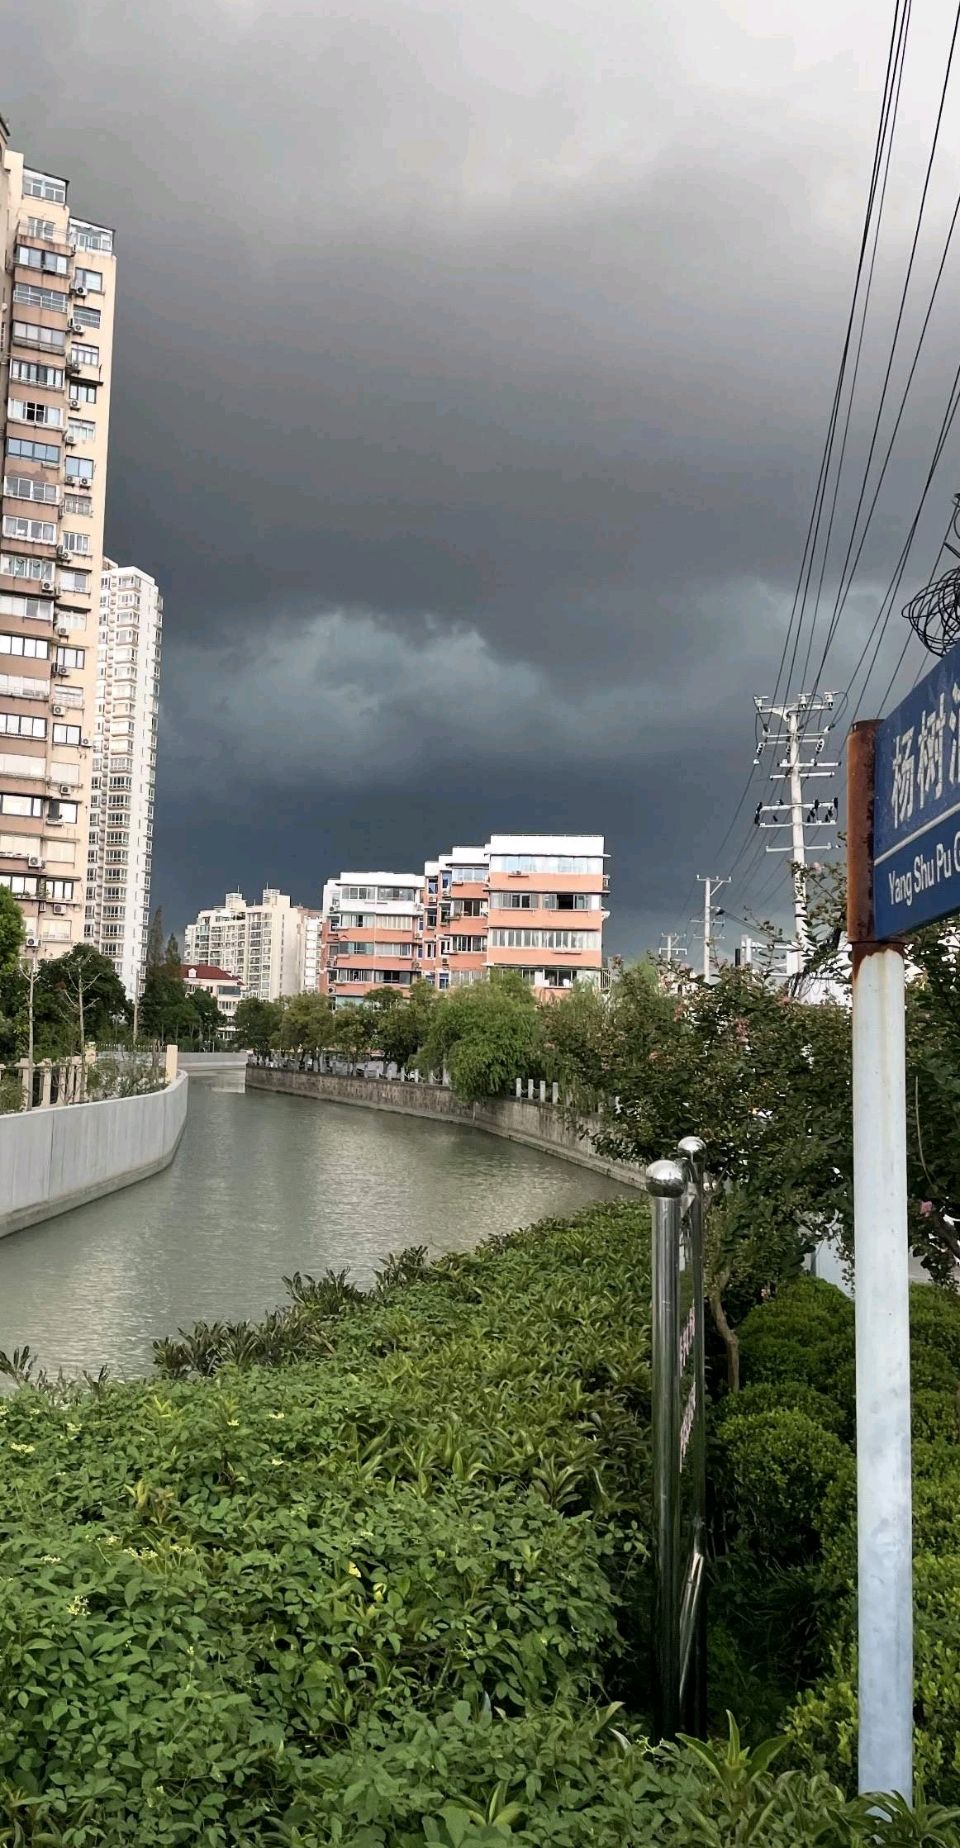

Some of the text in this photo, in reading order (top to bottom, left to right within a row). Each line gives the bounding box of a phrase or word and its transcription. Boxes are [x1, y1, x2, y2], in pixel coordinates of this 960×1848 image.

[888, 870, 912, 906] Yang
[914, 854, 935, 893] Shu
[936, 843, 952, 882] Pu
